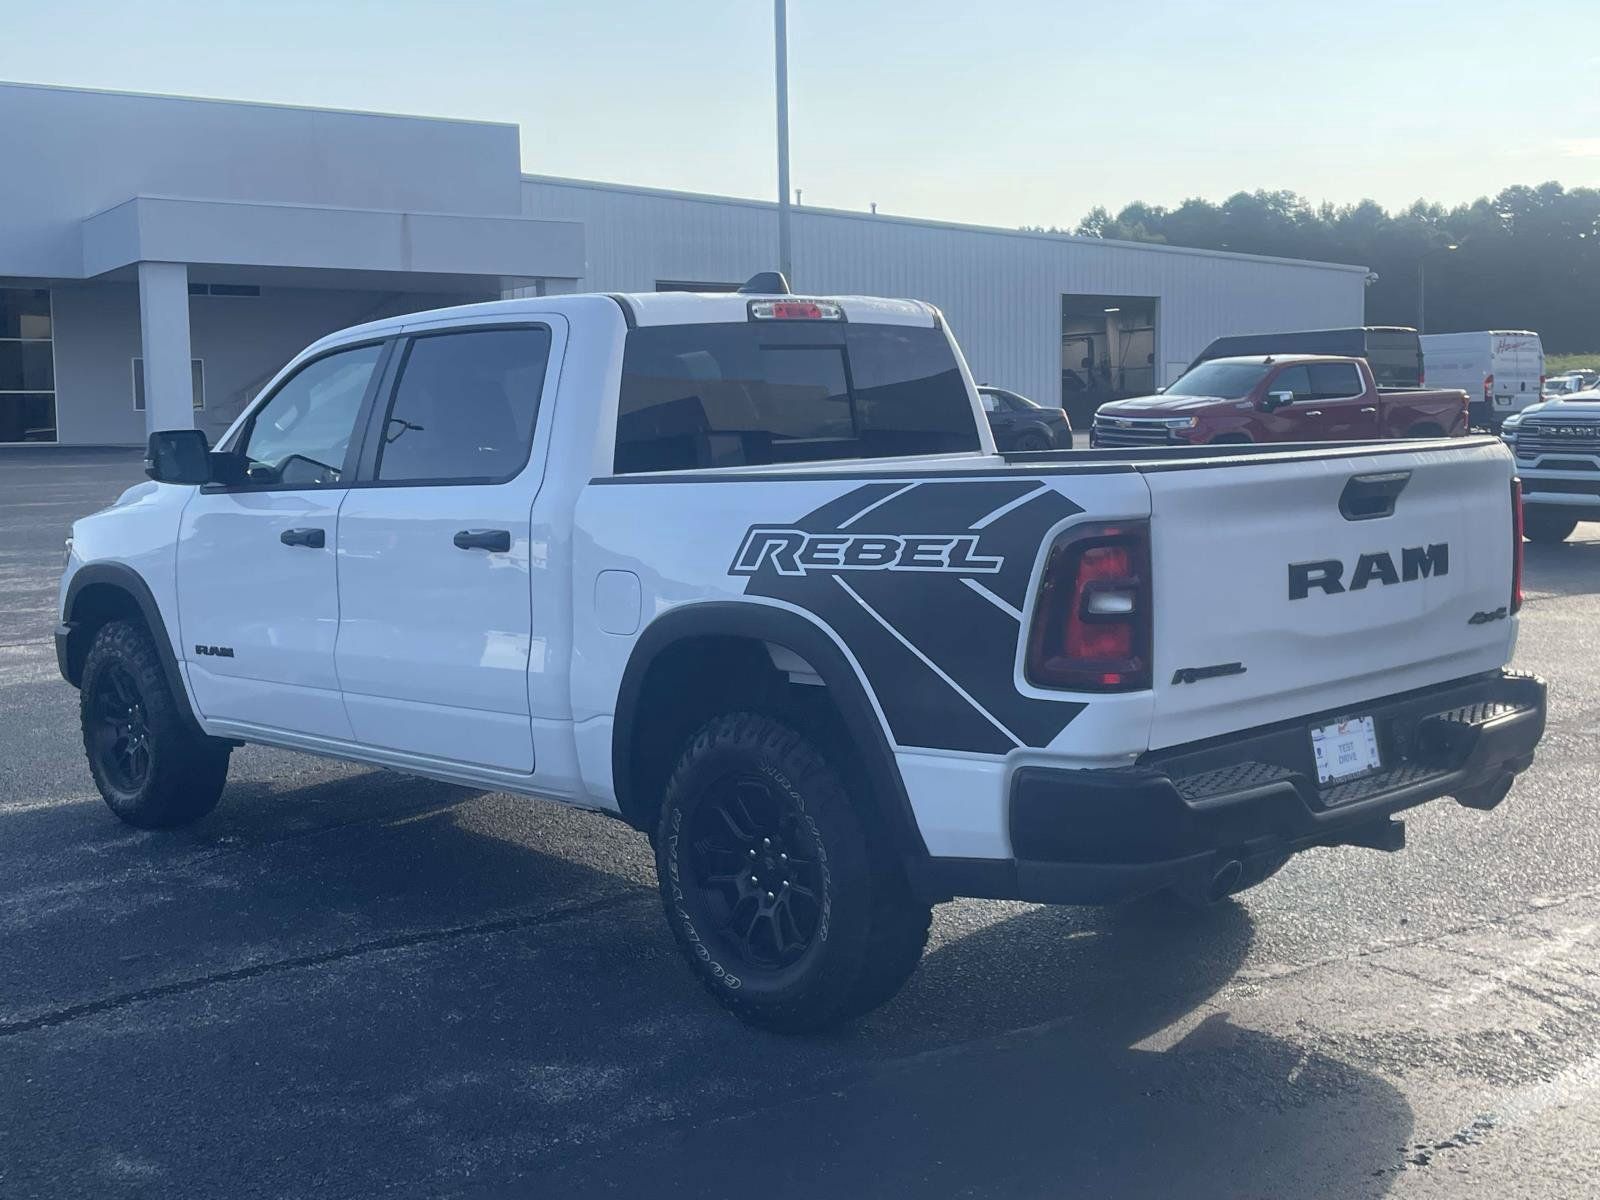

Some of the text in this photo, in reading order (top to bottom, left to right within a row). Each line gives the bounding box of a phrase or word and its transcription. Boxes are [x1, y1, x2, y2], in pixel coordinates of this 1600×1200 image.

[732, 528, 1005, 576] REBEL
[1288, 543, 1449, 600] RAM
[195, 645, 235, 658] RAM
